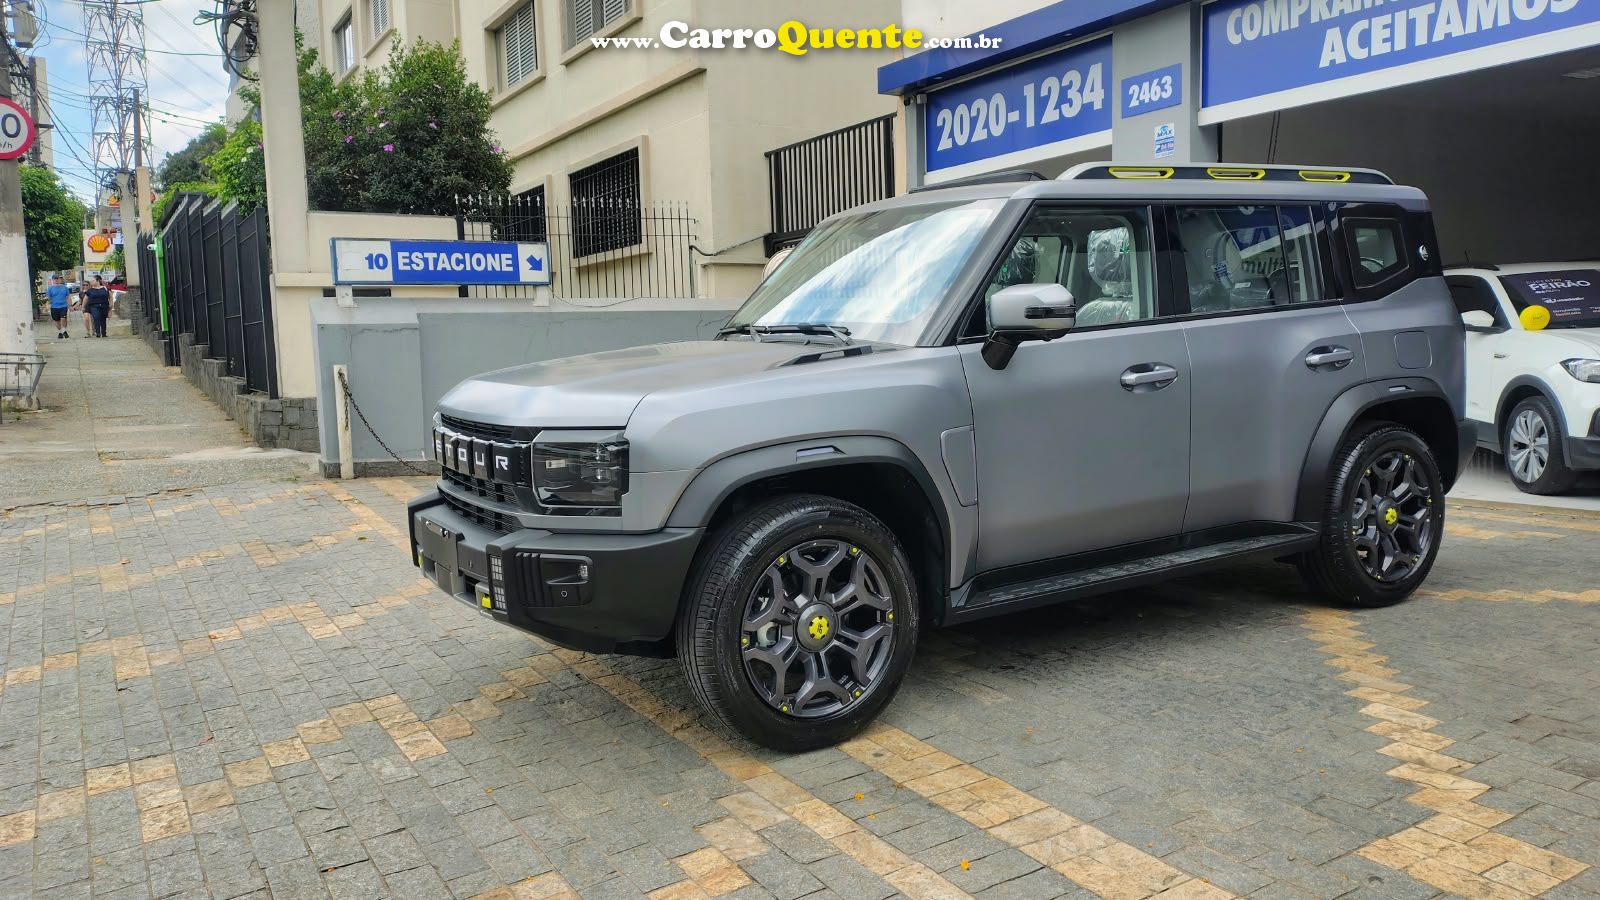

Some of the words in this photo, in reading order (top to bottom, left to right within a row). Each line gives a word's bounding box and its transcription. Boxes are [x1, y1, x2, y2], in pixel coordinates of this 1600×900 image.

[1318, 0, 1580, 69] ACEITAM
[936, 62, 1105, 152] 2020-1234
[1128, 75, 1173, 108] 2463
[0, 113, 21, 138] 0
[365, 252, 389, 271] 10
[397, 251, 514, 272] ESTACIONE
[434, 438, 508, 471] ETOUR
